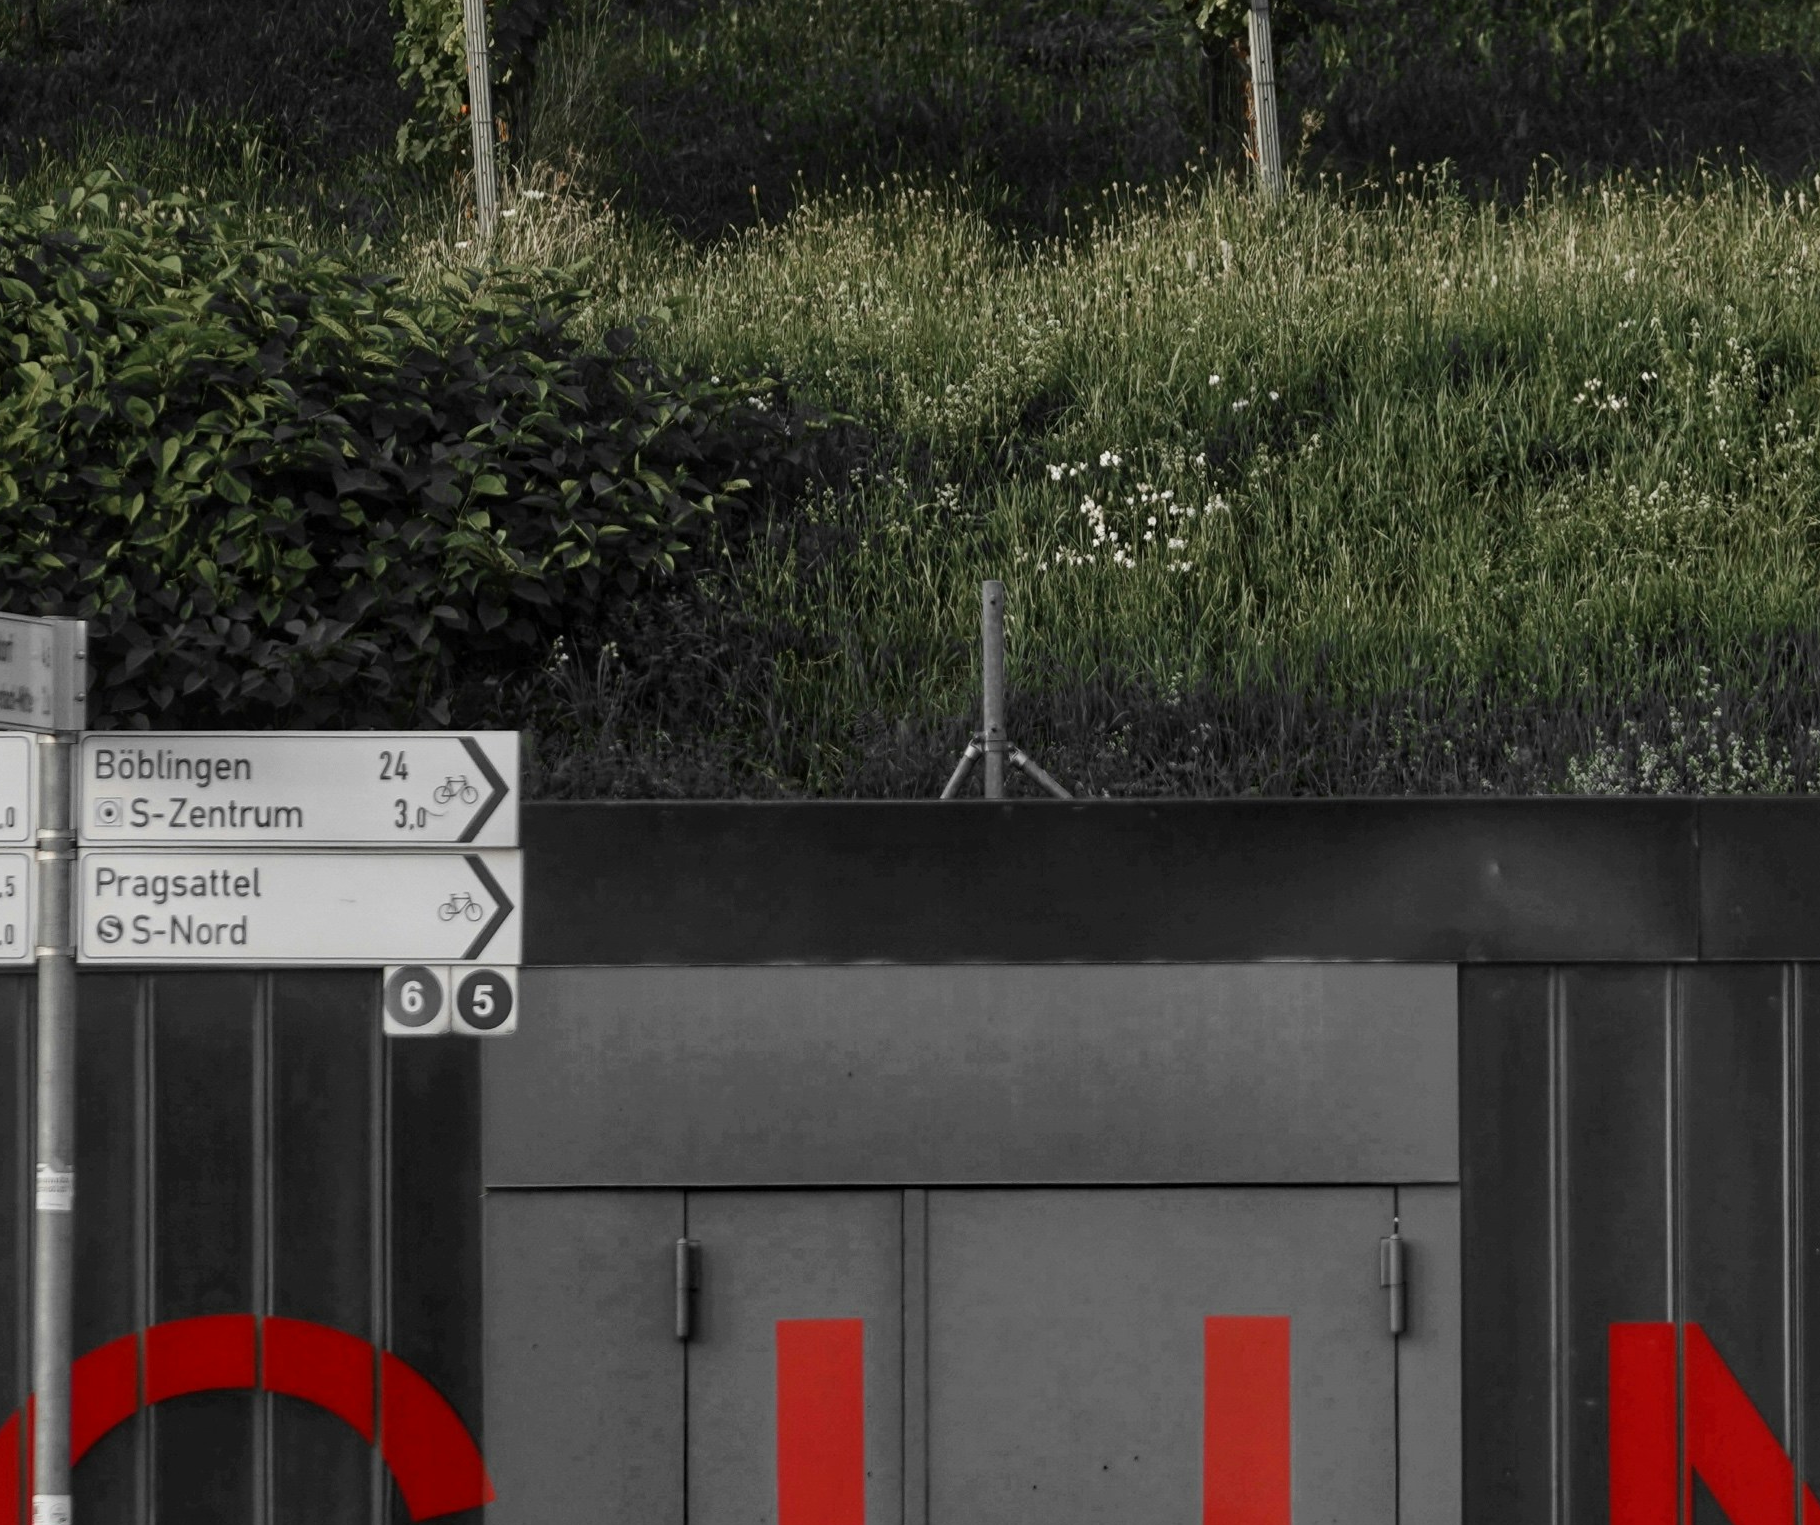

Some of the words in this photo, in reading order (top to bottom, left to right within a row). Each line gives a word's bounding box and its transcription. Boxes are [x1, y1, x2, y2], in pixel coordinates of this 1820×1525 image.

[94, 749, 252, 789] Böblingen
[378, 750, 409, 782] 24
[129, 797, 304, 829] S-Zentrum
[393, 798, 427, 831] 3,0
[94, 867, 262, 905] Pragsattel
[131, 914, 248, 945] S-Nord
[400, 979, 425, 1014] 6
[471, 984, 495, 1017] 5
